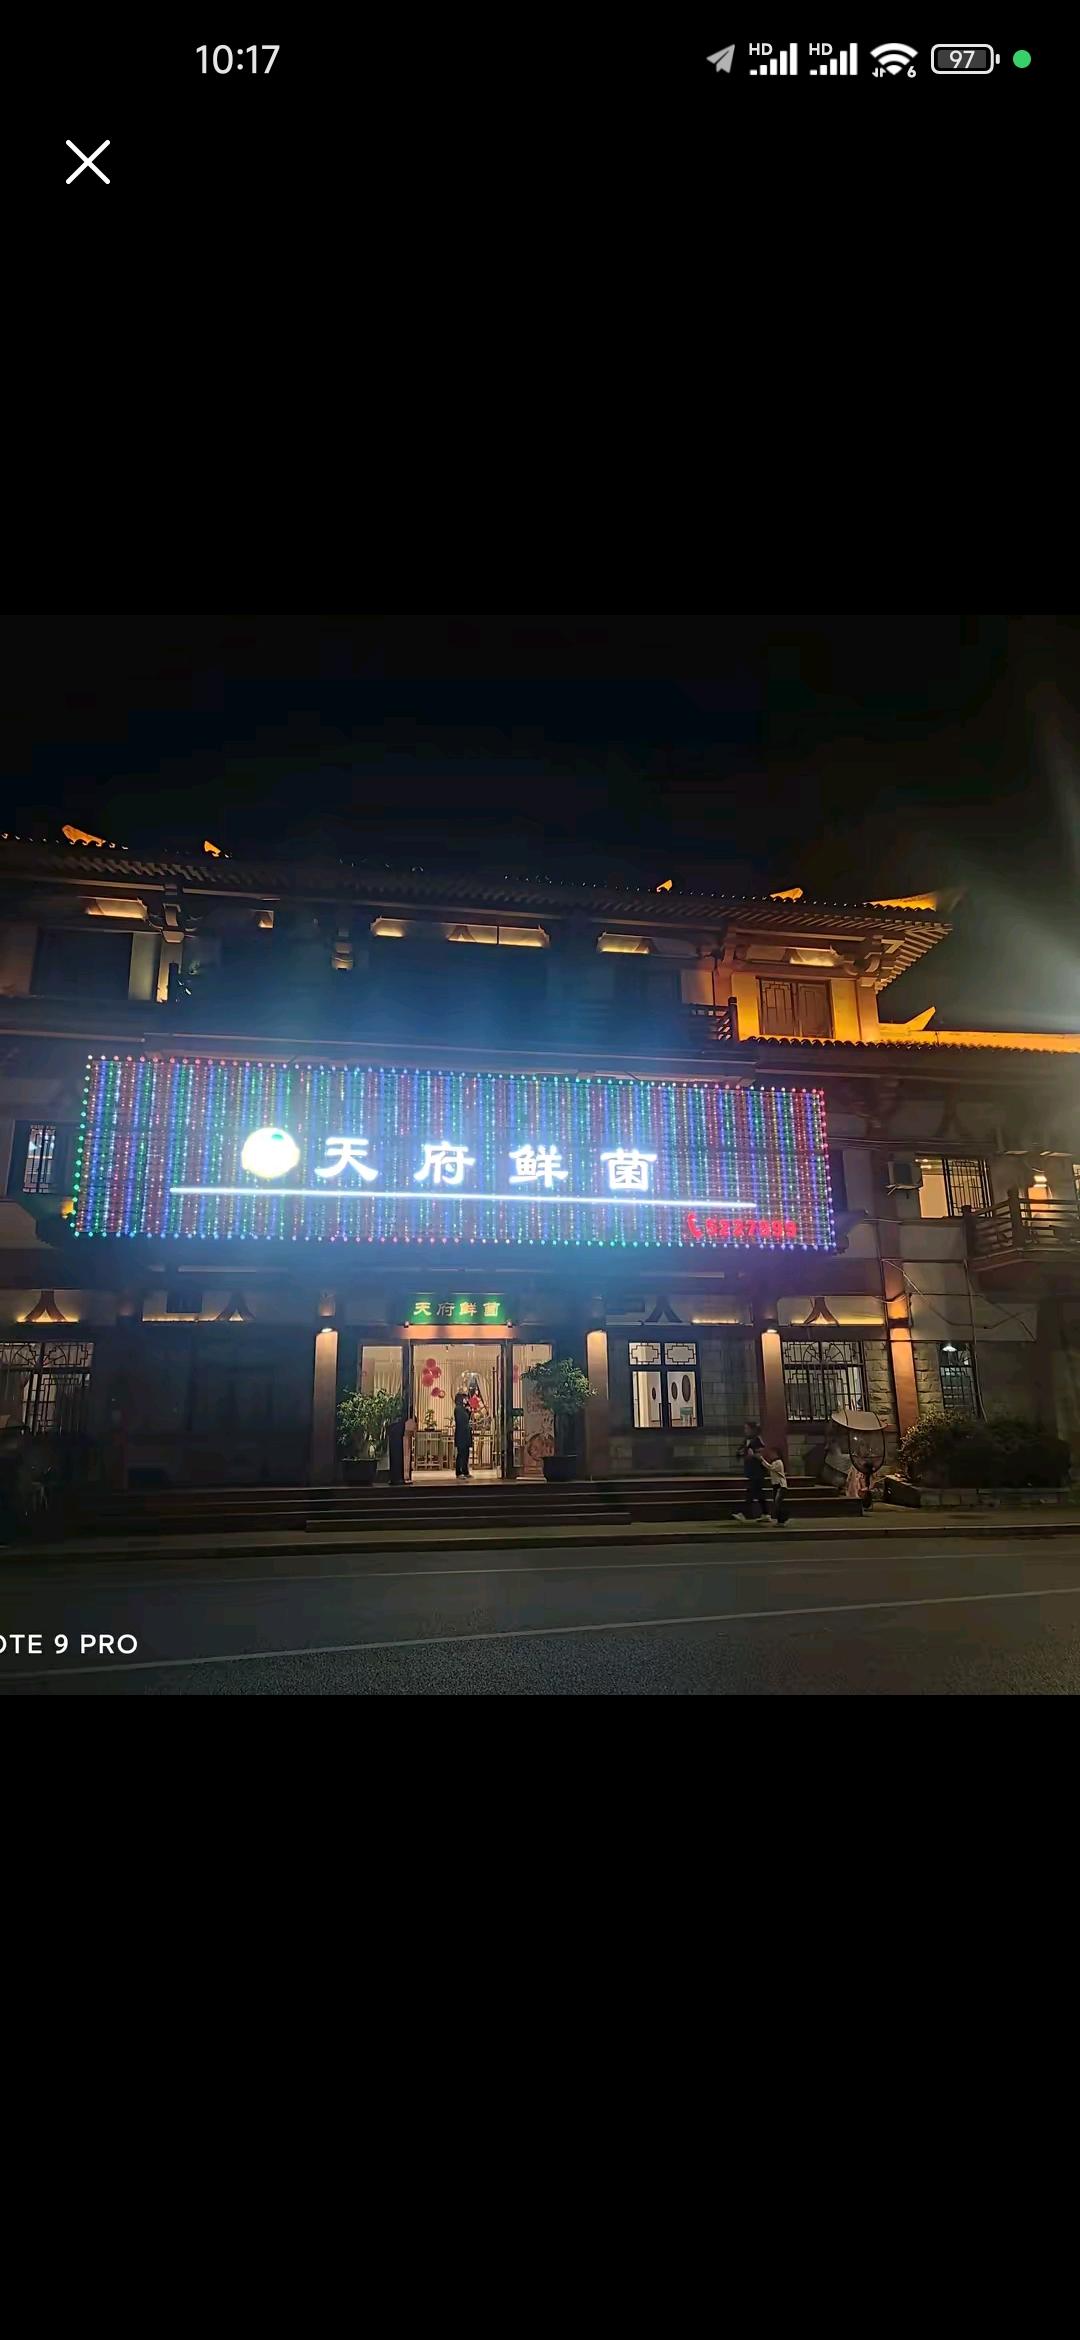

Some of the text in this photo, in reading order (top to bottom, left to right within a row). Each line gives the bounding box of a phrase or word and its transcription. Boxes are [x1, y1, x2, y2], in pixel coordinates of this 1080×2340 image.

[314, 1136, 659, 1191] 天府鲜菌
[413, 1301, 501, 1318] 天府鲜菌
